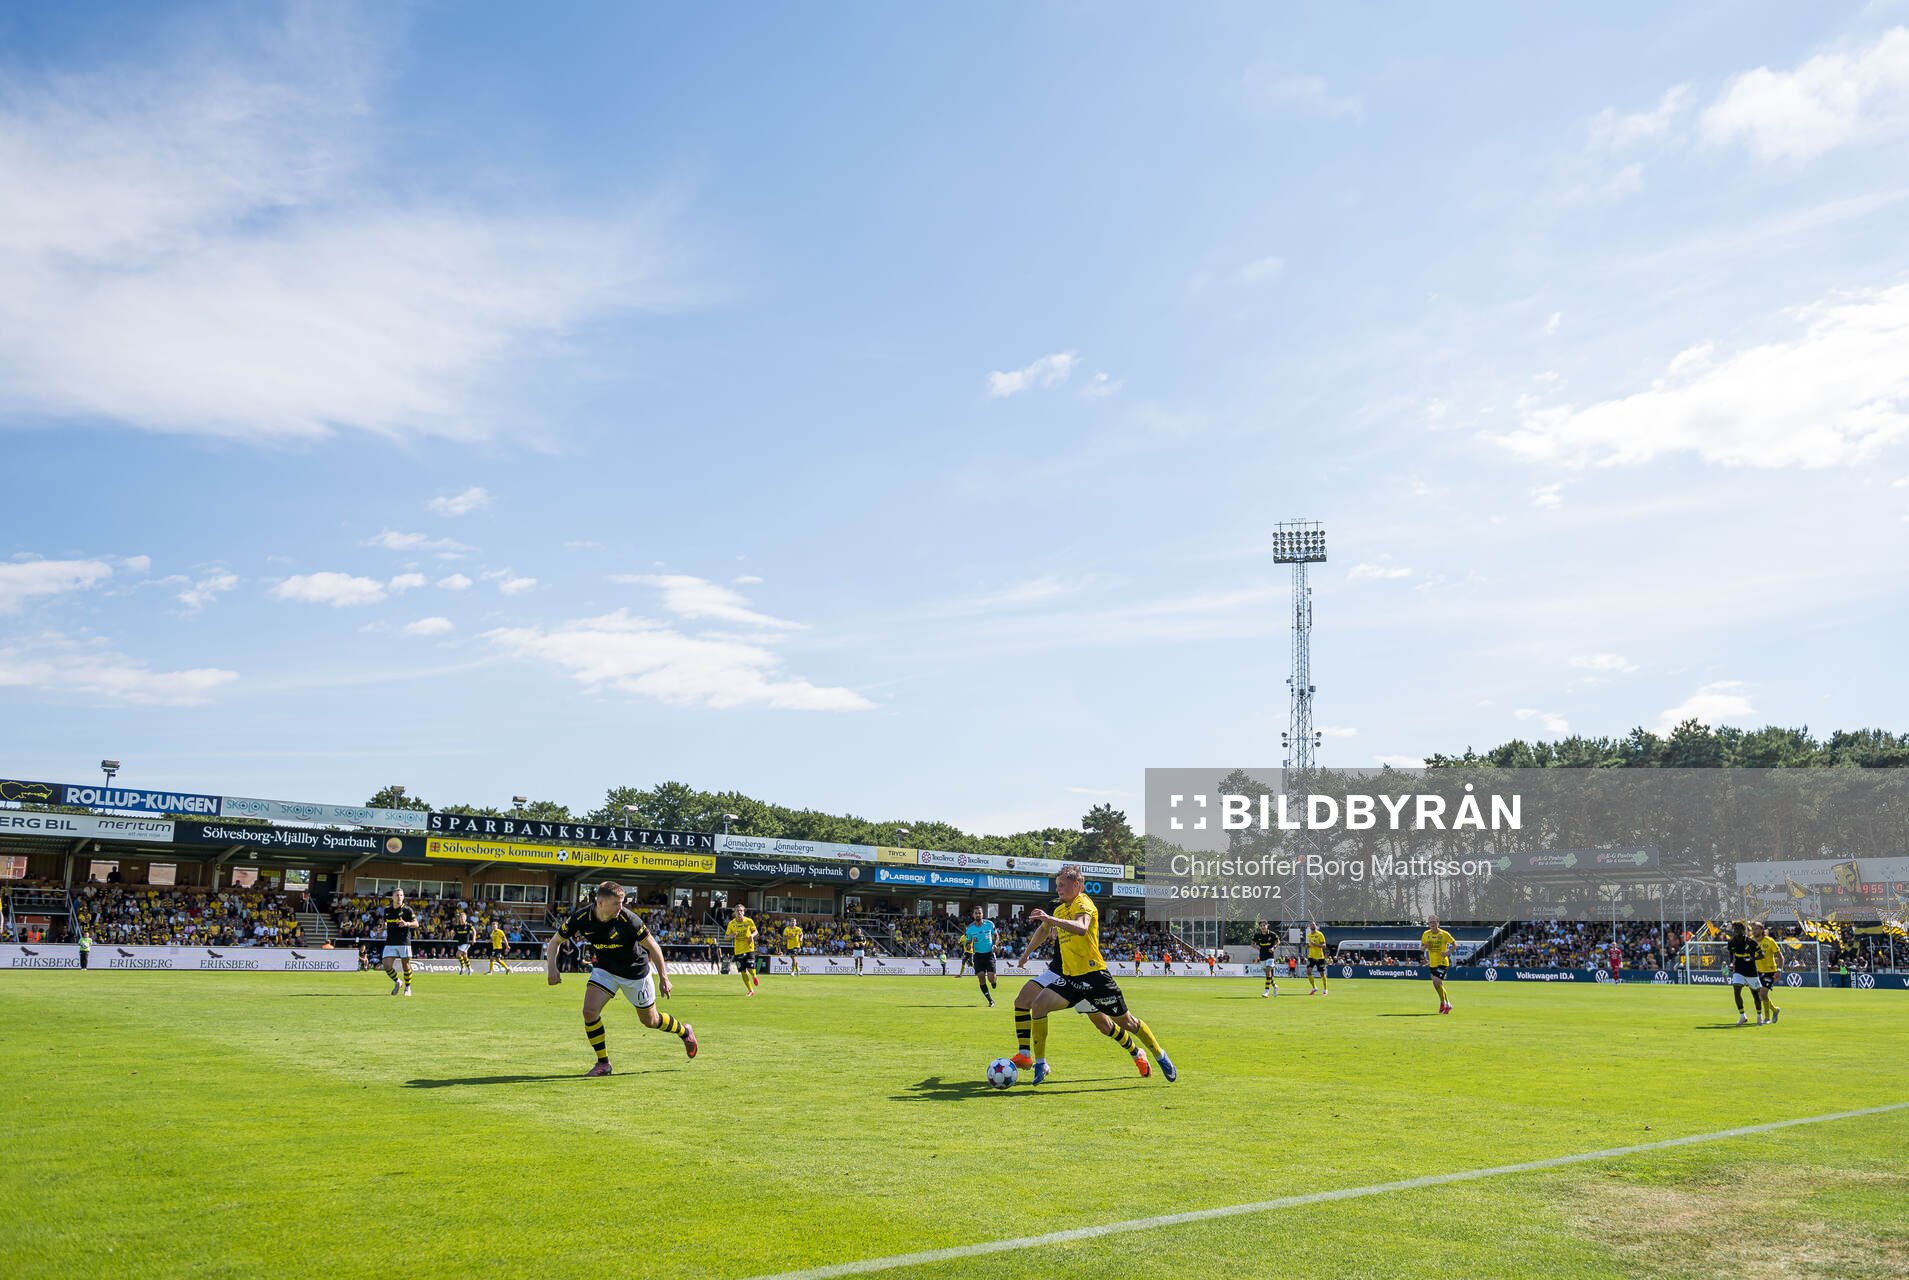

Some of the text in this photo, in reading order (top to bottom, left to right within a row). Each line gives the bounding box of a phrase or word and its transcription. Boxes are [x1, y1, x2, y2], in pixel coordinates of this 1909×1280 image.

[66, 787, 218, 814] ROLLUP-KUNGEN
[226, 799, 270, 813] SKOLON
[281, 805, 323, 818] SKOLON
[334, 808, 375, 821] SKOLON
[385, 811, 424, 825] SKOLON
[45, 819, 78, 831] BIL
[98, 820, 172, 832] meritum
[431, 813, 713, 848] SPARBANKSLÄKTAREN
[202, 826, 377, 850] Sölvesborg-Mjällby Sparbank
[722, 836, 766, 850] Lönneberga
[443, 841, 554, 859] Sölvesborgs kommun
[773, 839, 814, 854] Lönneberga
[571, 850, 609, 864] Mjällby
[641, 855, 700, 869] hemmaplan
[732, 860, 844, 877] Sölvesborg-Mjällby Sparbank
[1082, 865, 1122, 875] THERMOBOX
[889, 873, 926, 882] LARSSON
[939, 876, 974, 885] LARSSON
[987, 875, 1041, 890] NORRVIDINGE
[12, 957, 81, 968] ERIKSBERG
[109, 958, 173, 969] ERIKSBERG
[200, 959, 259, 969] ERIKSBERG
[284, 960, 340, 970] ERIKSBERG
[773, 965, 810, 973] ERIKSRG
[1368, 969, 1405, 977] Volkswagen
[1516, 971, 1575, 981] Volkswagen ID.4
